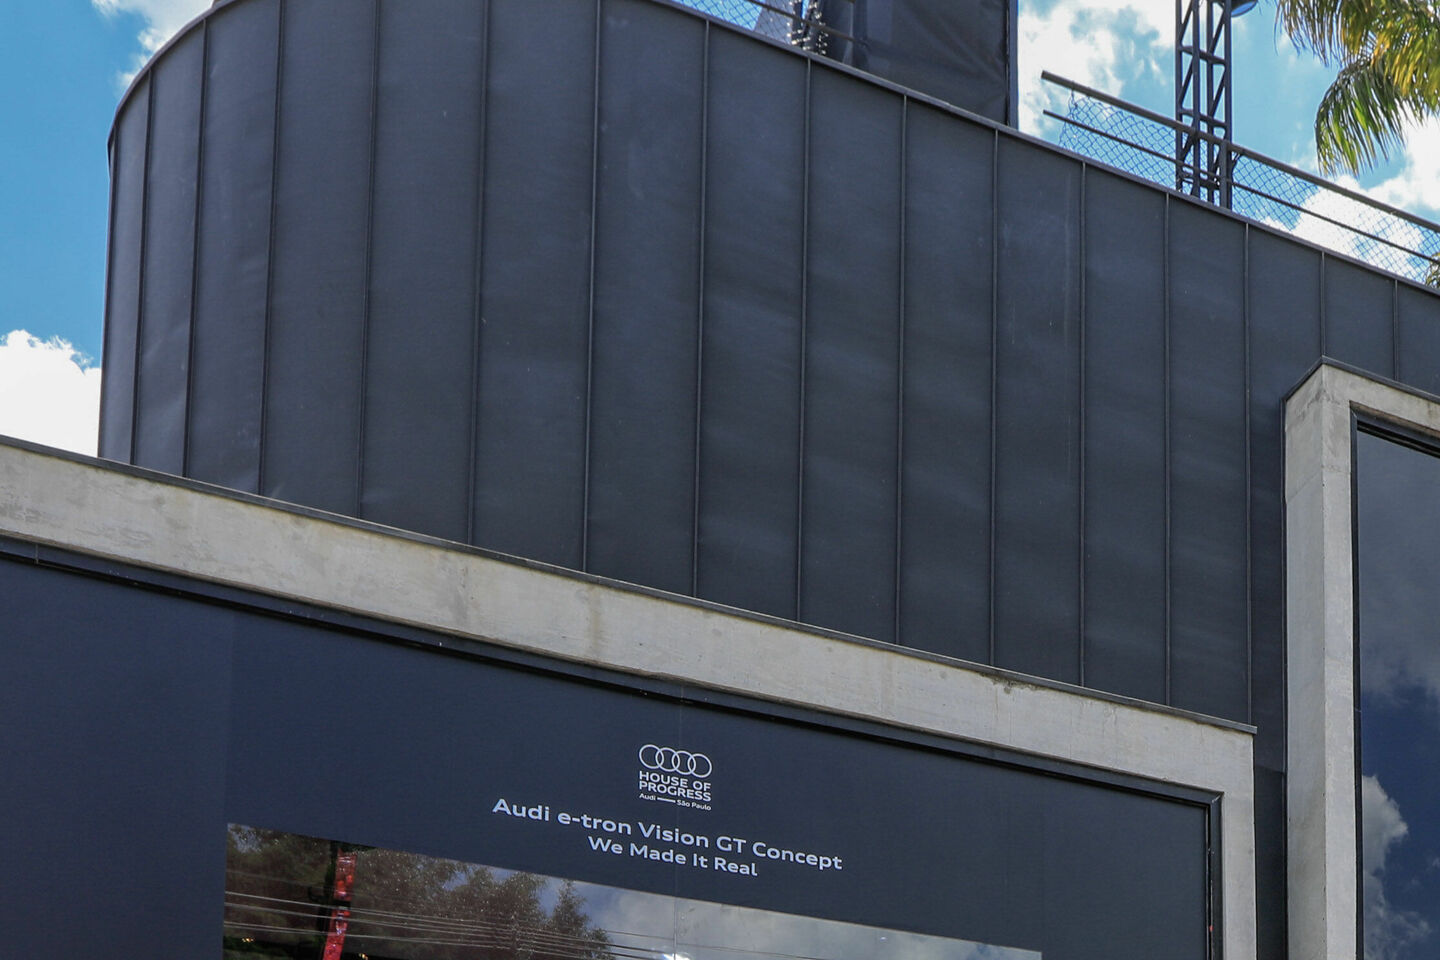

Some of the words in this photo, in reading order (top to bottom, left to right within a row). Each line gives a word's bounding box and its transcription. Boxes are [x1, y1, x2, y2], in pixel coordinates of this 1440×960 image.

[639, 771, 688, 788] HOUSE
[692, 780, 712, 792] OF
[639, 780, 711, 801] PROGRESS
[639, 793, 656, 801] Audi
[691, 802, 712, 811] Paulo
[492, 798, 550, 822] Audi
[557, 812, 632, 836] e-tron
[637, 822, 709, 848] Vision
[716, 836, 746, 853] GT
[751, 842, 843, 871] Concept
[588, 836, 623, 855] We
[629, 844, 686, 865] Made
[692, 853, 708, 868] It
[714, 857, 758, 877] Real
